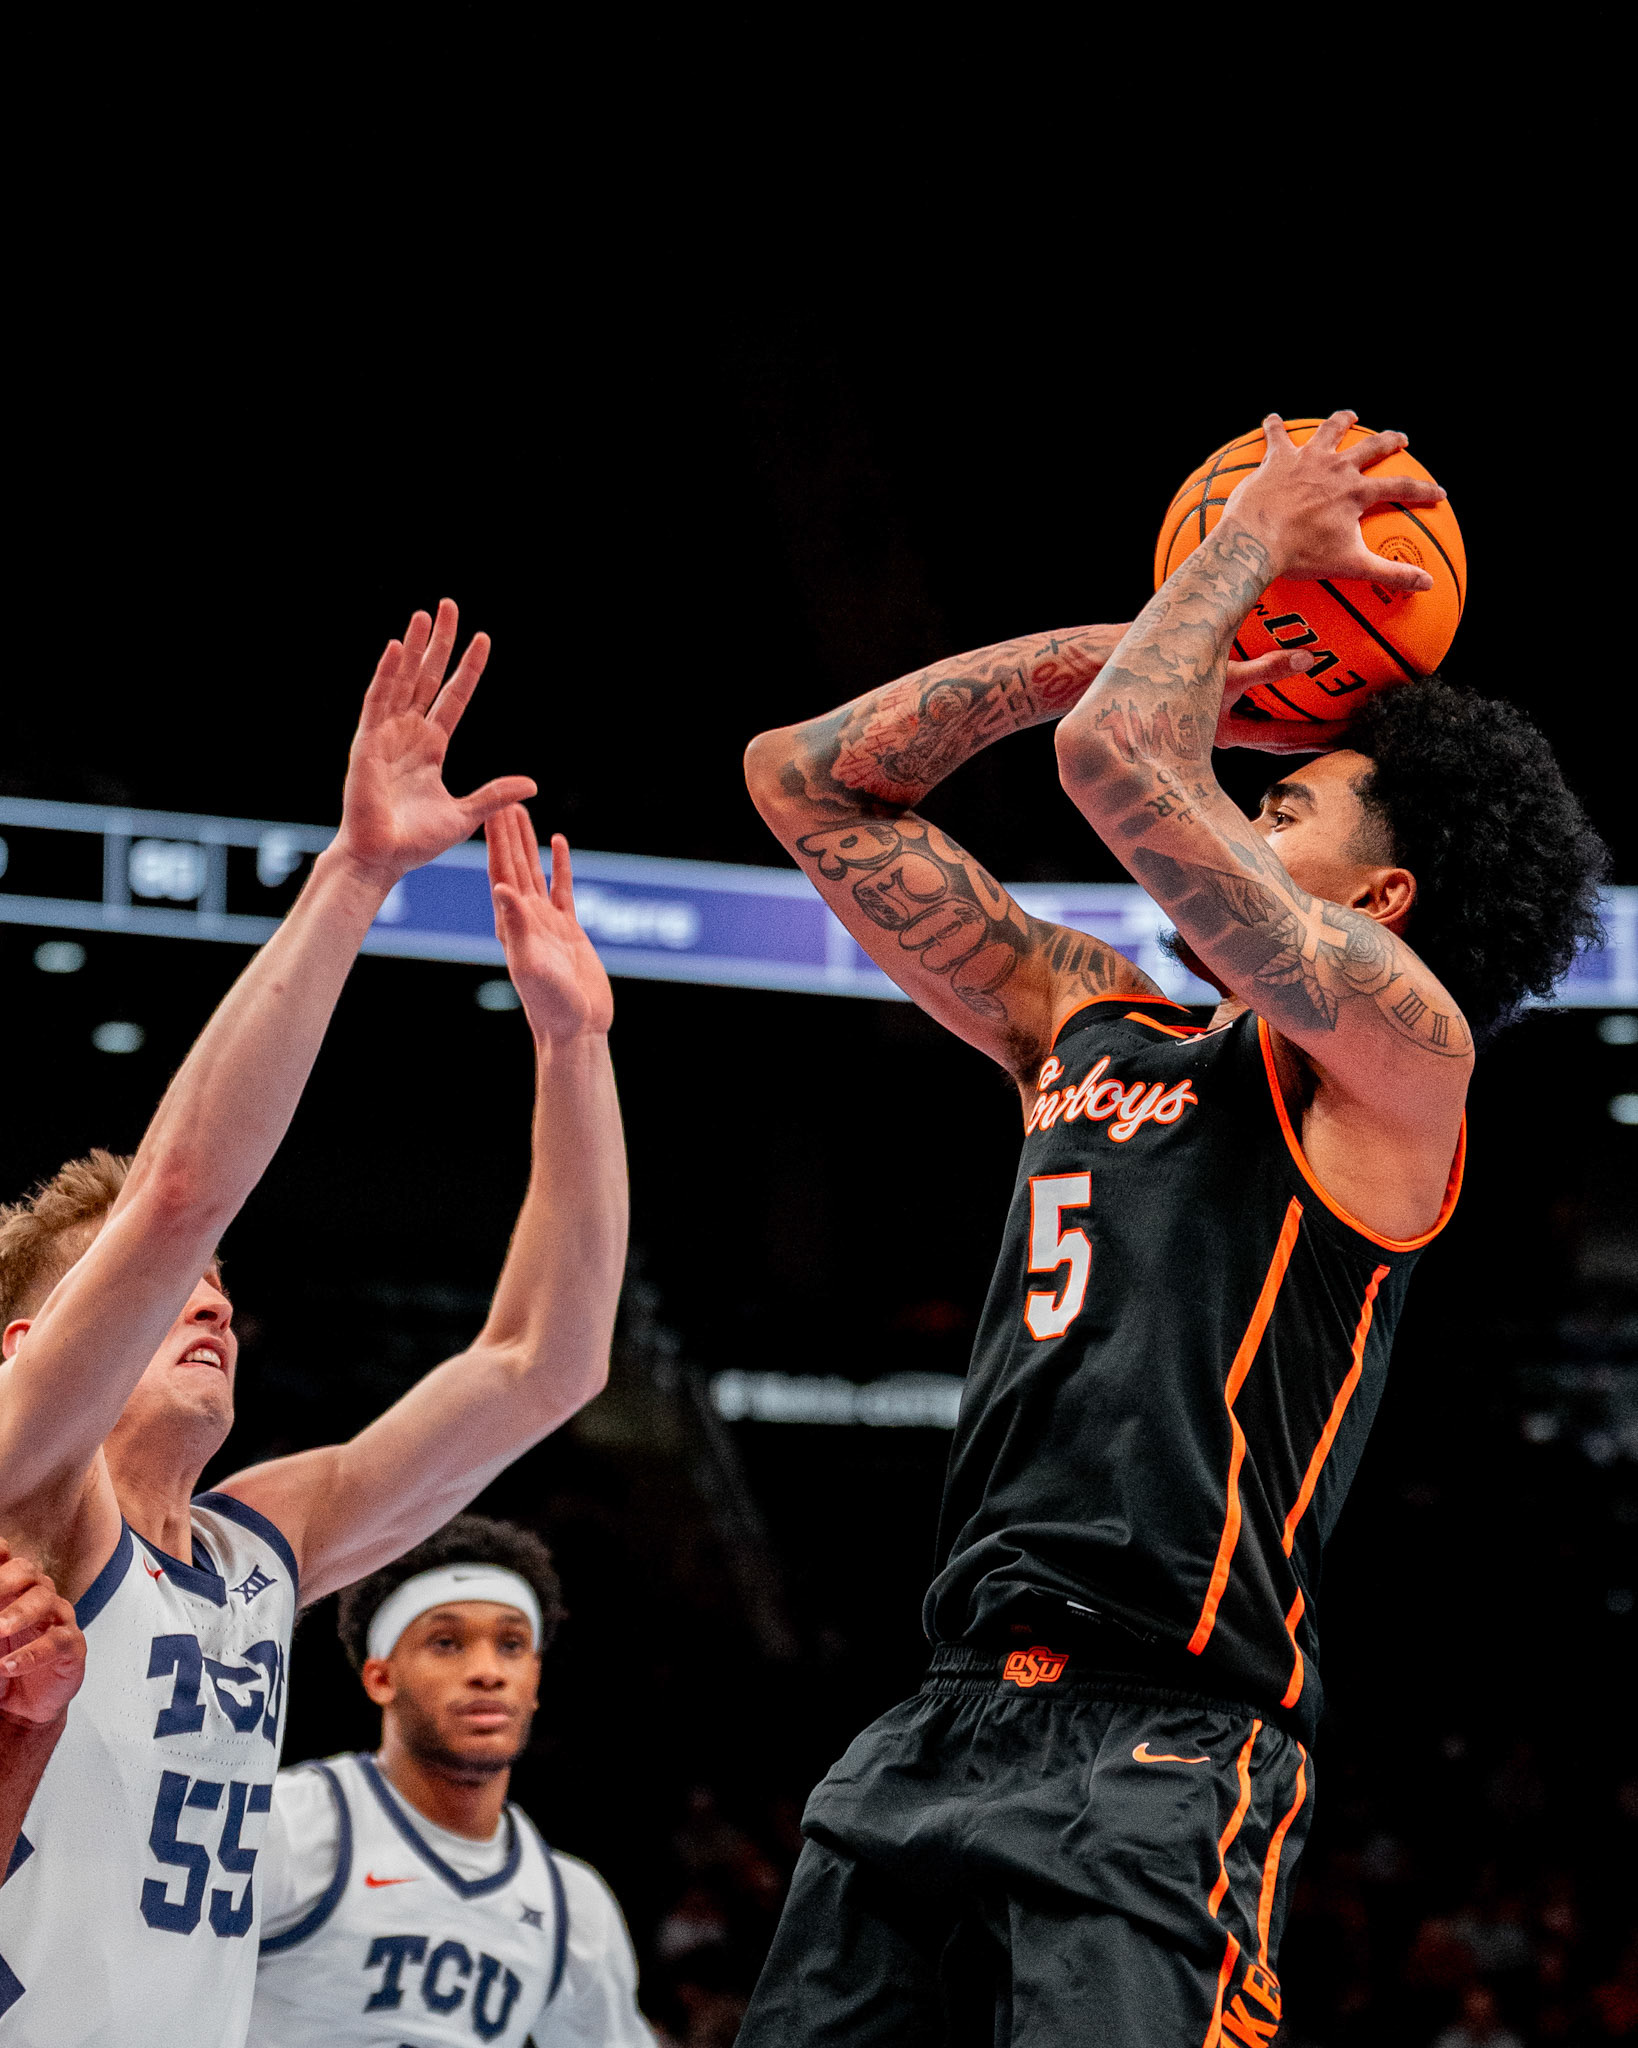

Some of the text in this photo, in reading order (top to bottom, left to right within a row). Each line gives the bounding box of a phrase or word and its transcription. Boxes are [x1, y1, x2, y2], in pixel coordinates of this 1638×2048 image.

[1024, 1171, 1093, 1341] 5
[1003, 1646, 1070, 1688] OSU
[140, 1770, 273, 1938] 55
[362, 1934, 523, 2045] TCU
